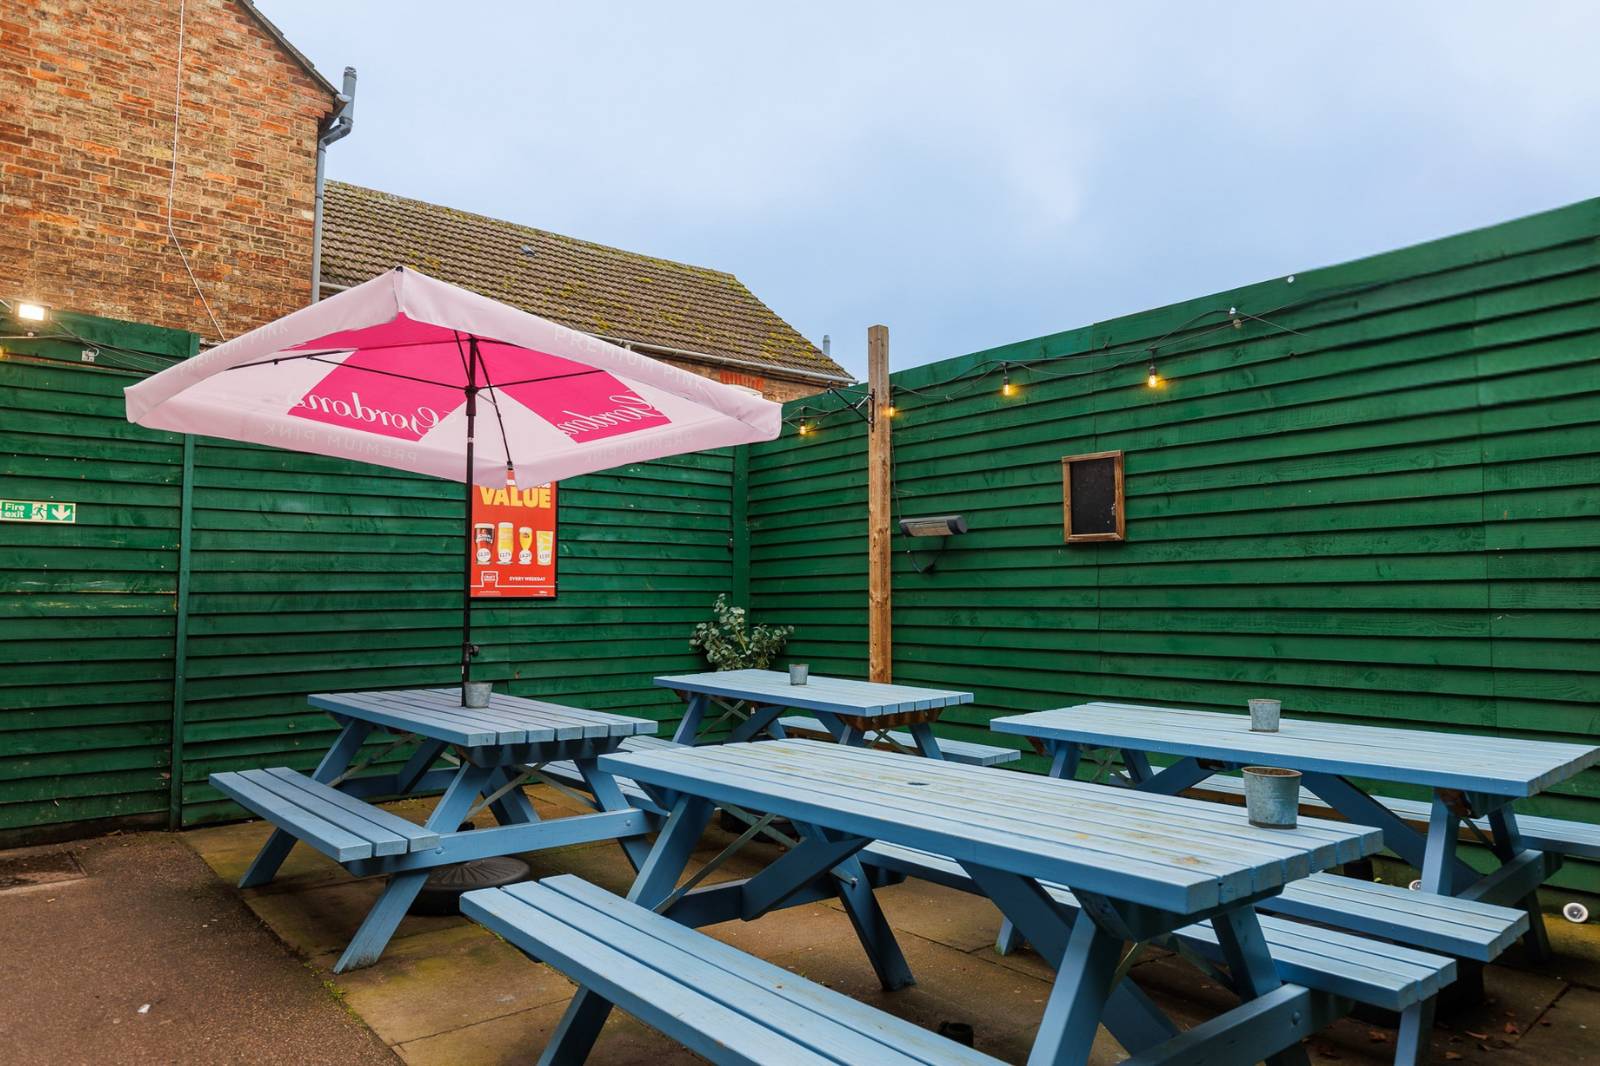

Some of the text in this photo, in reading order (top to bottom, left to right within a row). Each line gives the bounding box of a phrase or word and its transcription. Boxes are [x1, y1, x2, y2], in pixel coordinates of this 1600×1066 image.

[553, 326, 654, 370] PREMIUM
[5, 503, 25, 511] Fire
[480, 486, 552, 509] VALUE
